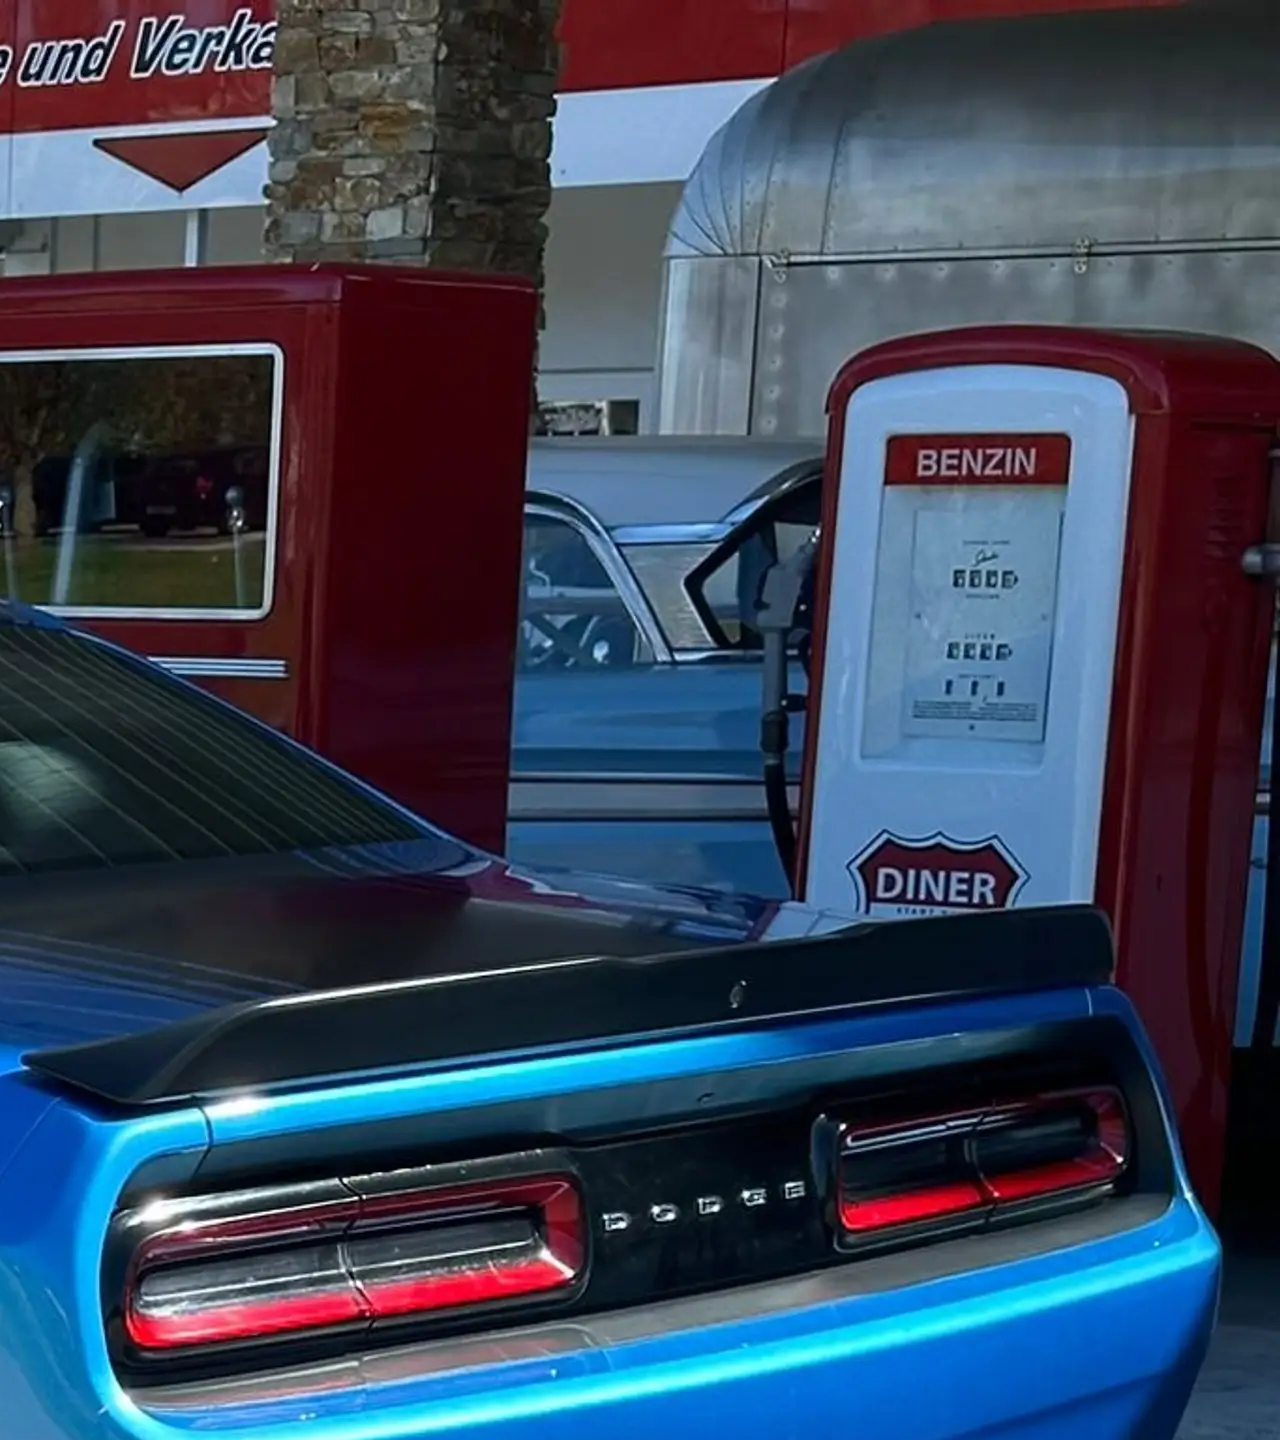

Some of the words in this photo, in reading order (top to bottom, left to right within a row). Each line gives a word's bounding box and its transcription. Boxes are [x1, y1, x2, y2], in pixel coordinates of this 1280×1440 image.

[17, 20, 125, 88] und
[915, 447, 1038, 478] BENZIN
[875, 866, 997, 905] DINER
[602, 1180, 807, 1232] DODGE
